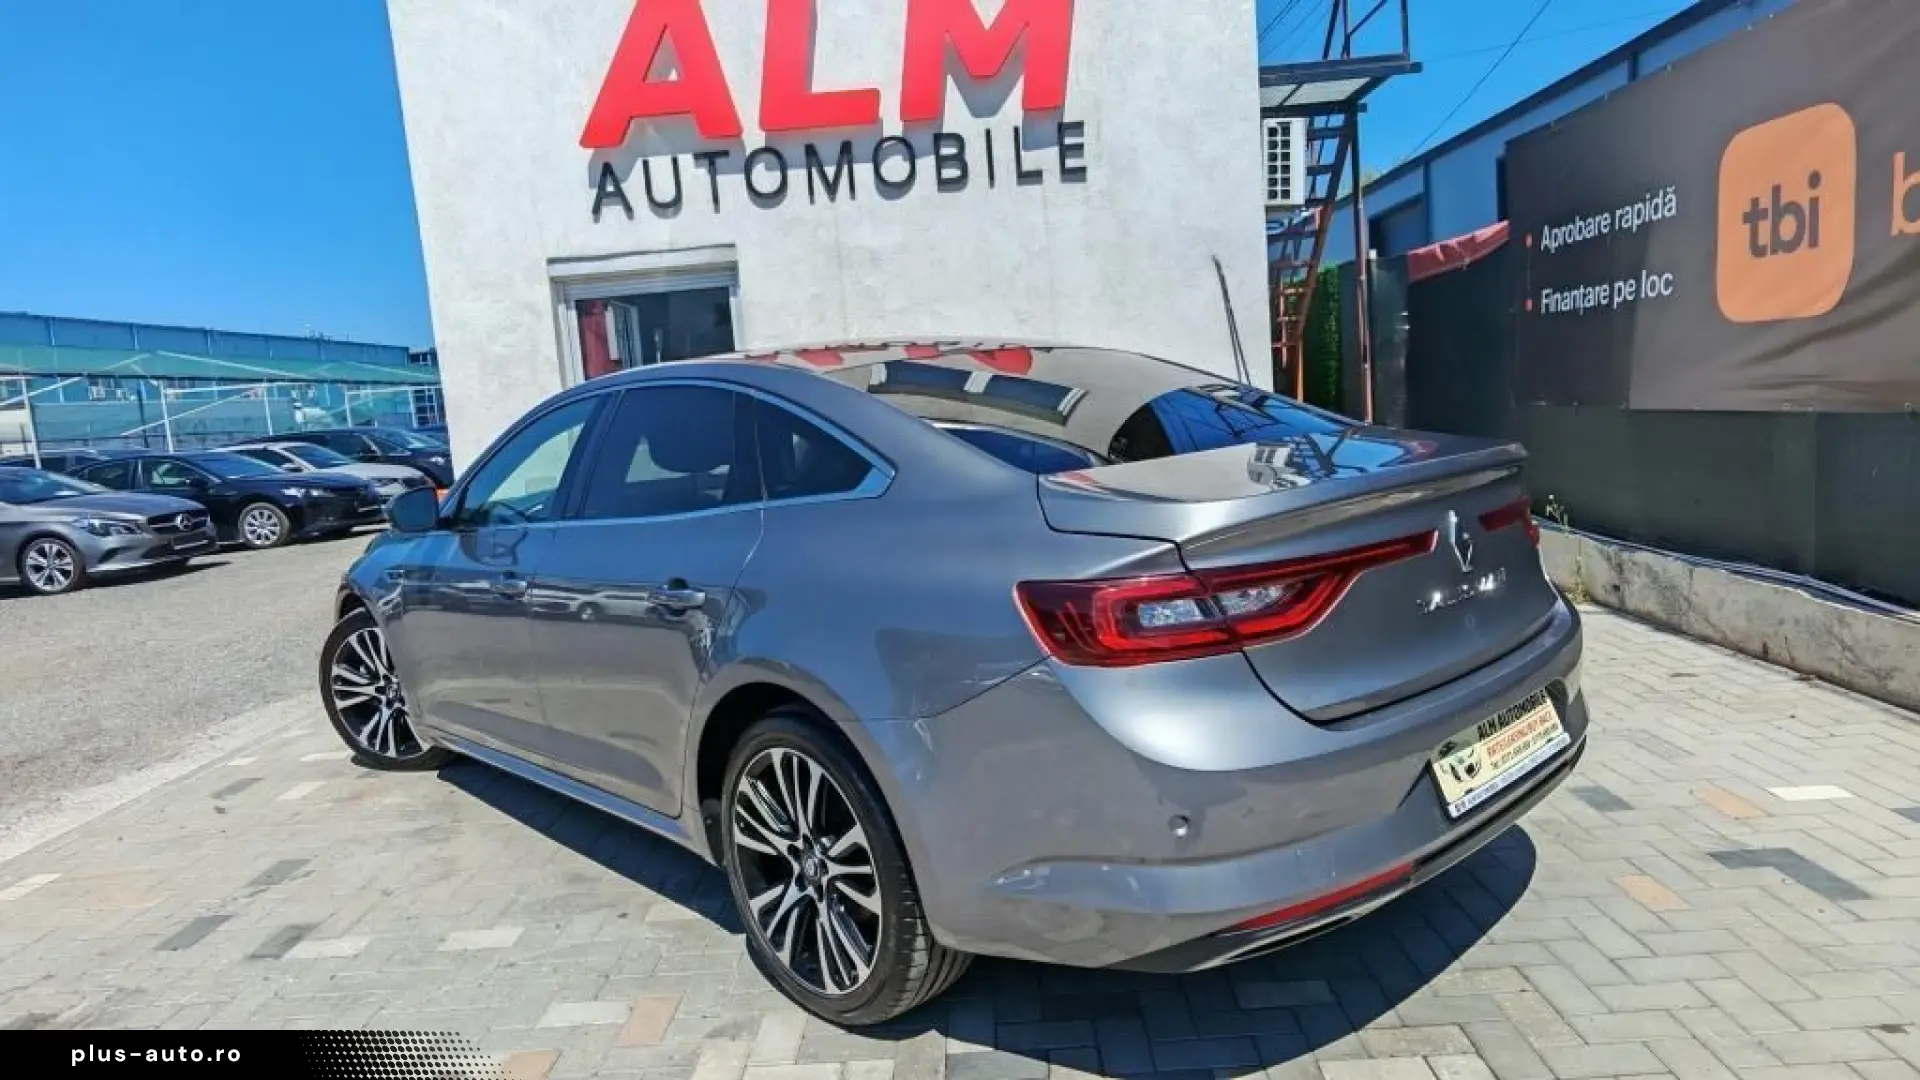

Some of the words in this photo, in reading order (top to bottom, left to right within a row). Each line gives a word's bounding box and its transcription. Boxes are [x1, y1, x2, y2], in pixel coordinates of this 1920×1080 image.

[579, 0, 1074, 149] ALM
[591, 119, 1088, 222] AUTOMOBILE
[1741, 169, 1822, 258] tbi
[1540, 210, 1612, 254] Aprobare
[1615, 185, 1677, 233] rapidă
[1540, 284, 1610, 316] Finanțare
[1613, 277, 1636, 310] pe
[1640, 269, 1674, 299] loc
